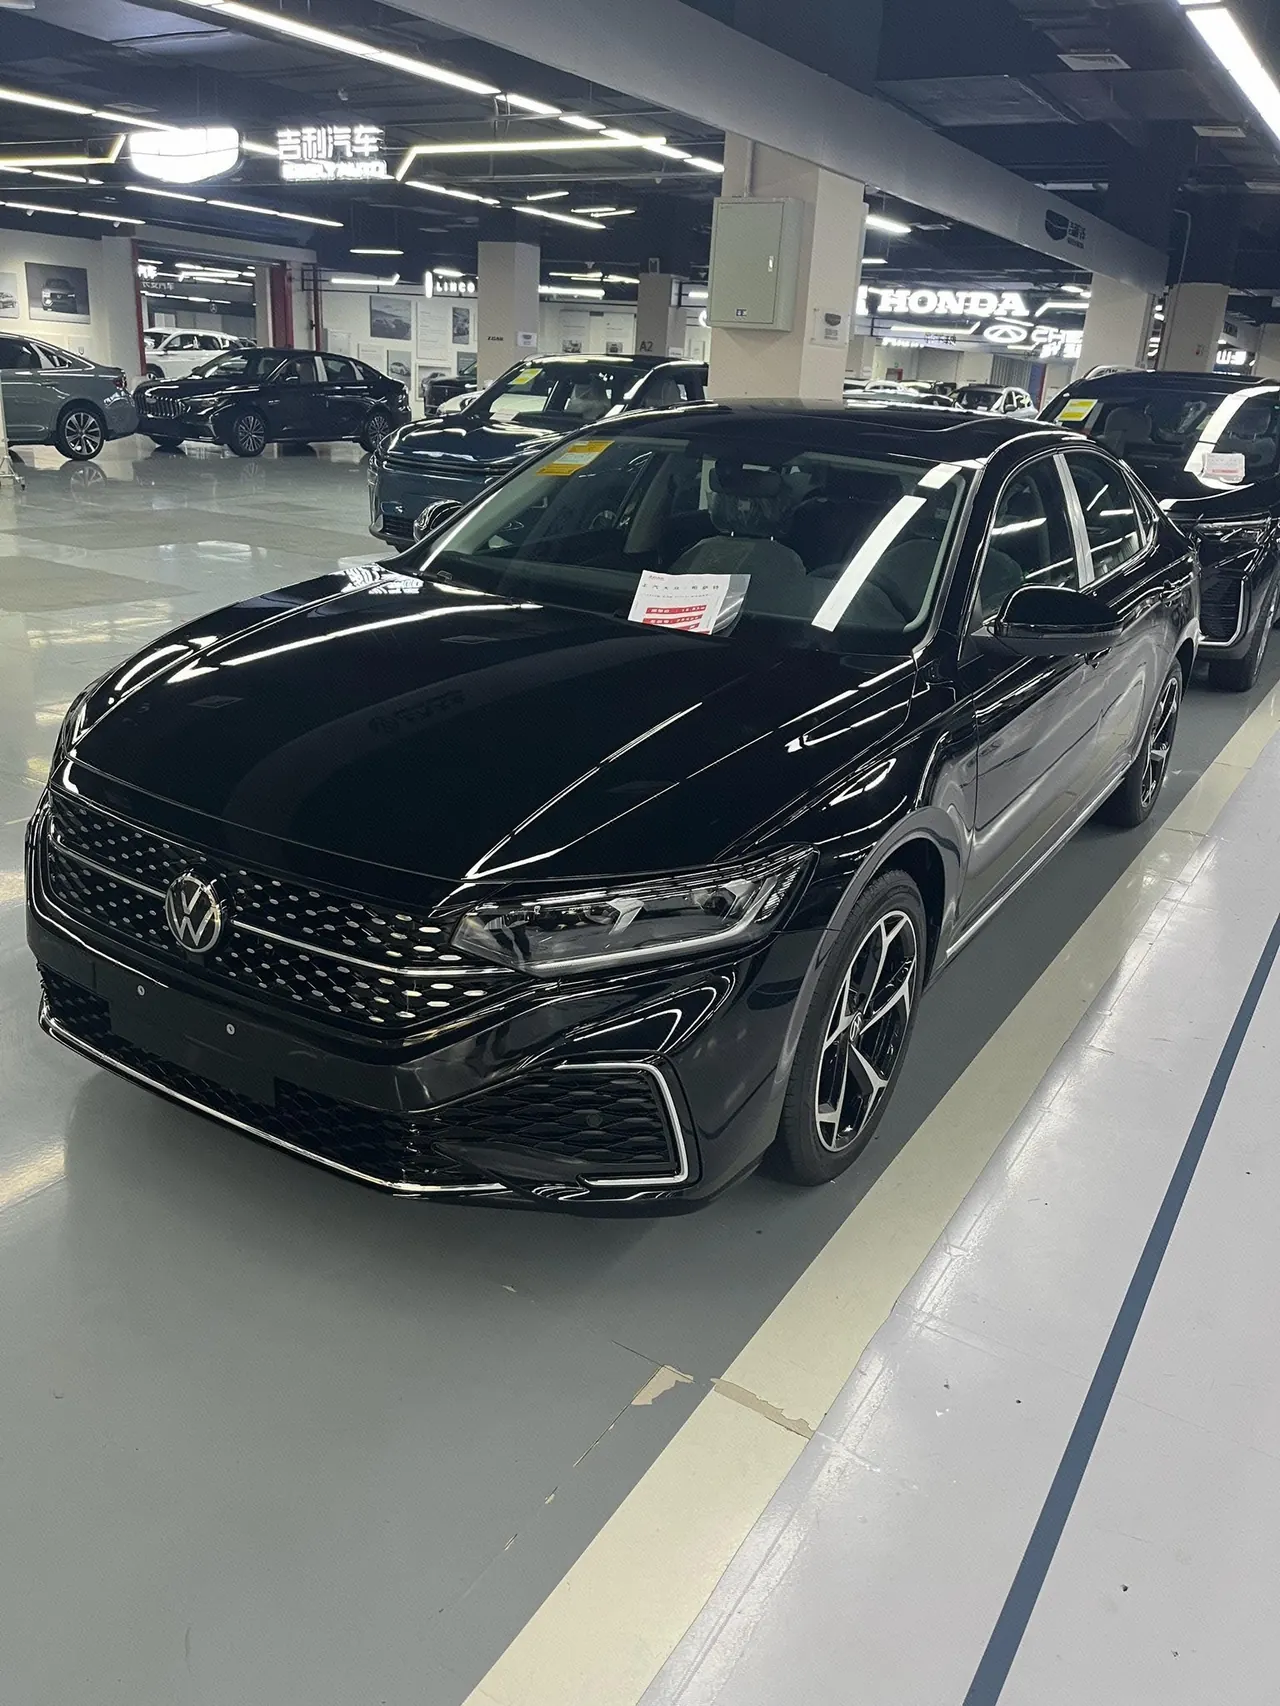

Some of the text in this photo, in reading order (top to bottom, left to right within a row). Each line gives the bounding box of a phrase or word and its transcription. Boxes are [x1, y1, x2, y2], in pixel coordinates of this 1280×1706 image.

[277, 125, 384, 160] 吉利汽车
[877, 288, 1029, 317] HONDA
[639, 341, 653, 352] A2
